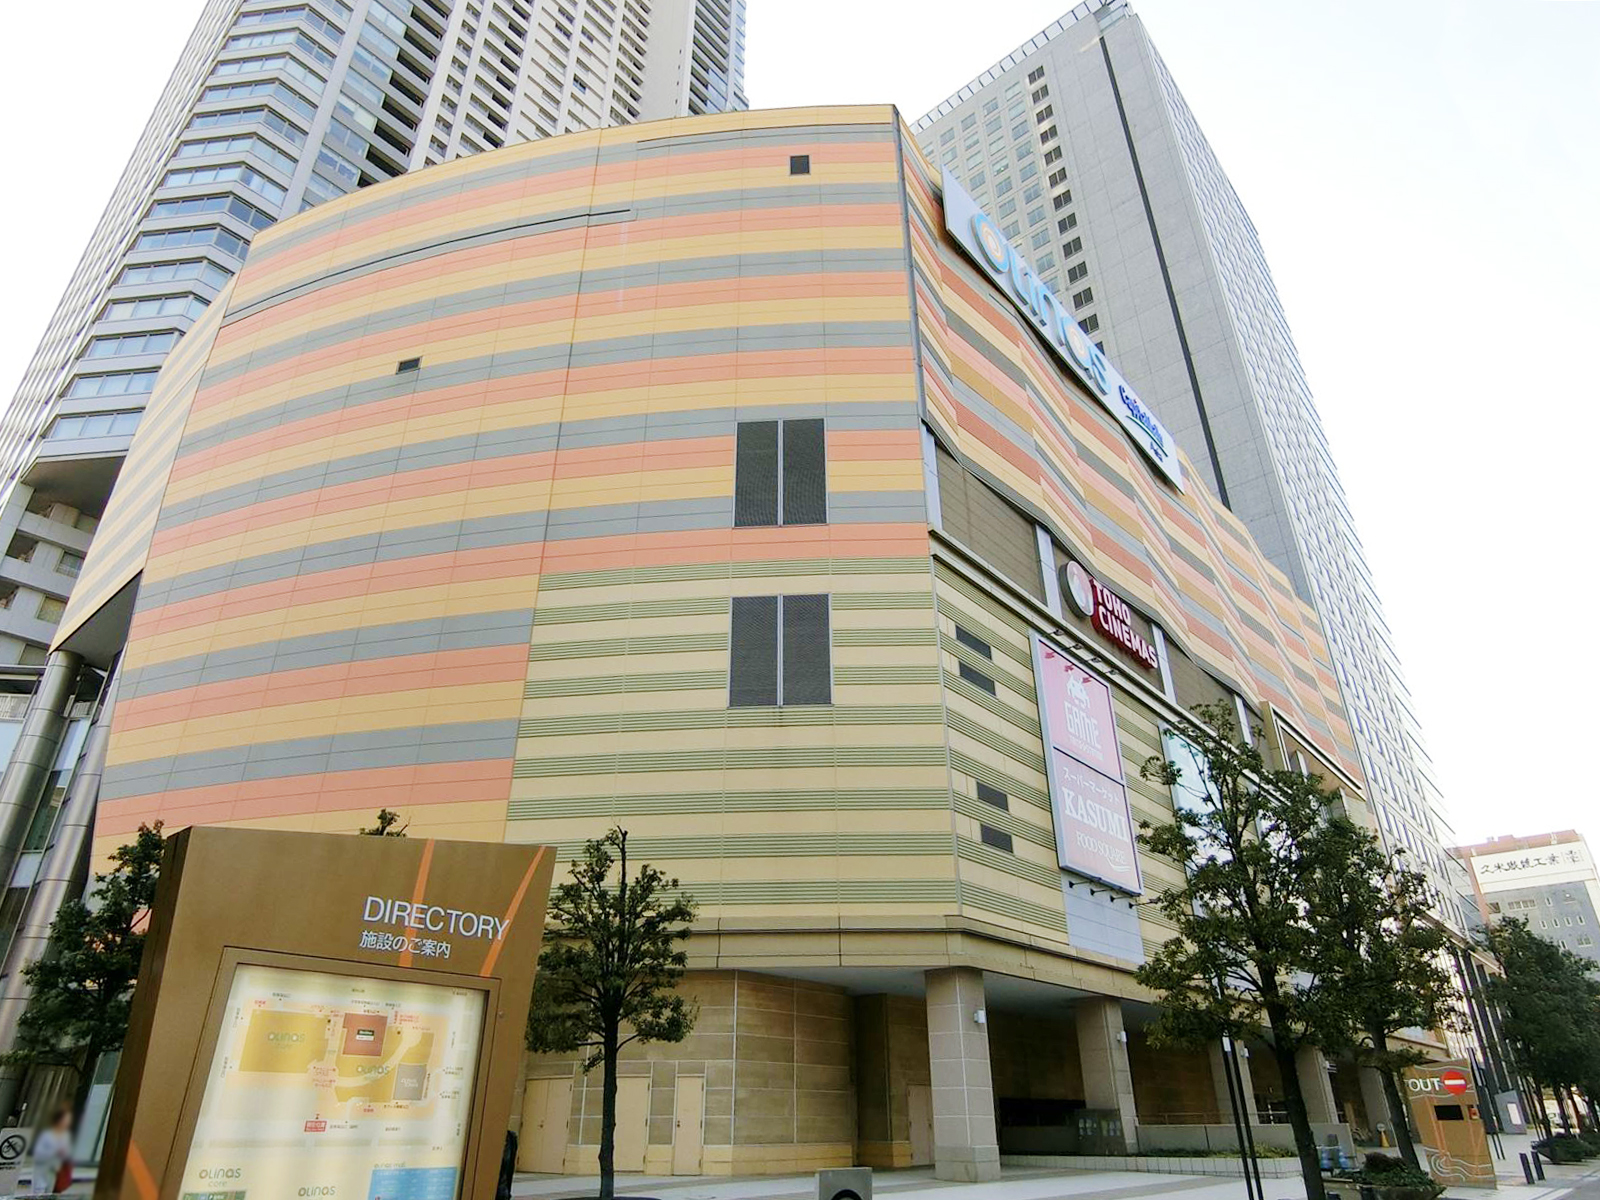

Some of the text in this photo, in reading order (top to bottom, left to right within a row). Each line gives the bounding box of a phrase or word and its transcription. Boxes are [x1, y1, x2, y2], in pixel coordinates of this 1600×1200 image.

[1092, 577, 1131, 626] TOHO
[1098, 605, 1158, 669] CINEMAS
[1061, 786, 1129, 843] KASUMI
[1076, 830, 1098, 852] FOOD
[363, 896, 510, 941] DIRECTORY
[359, 930, 451, 959] 施設のご案内
[1408, 1077, 1440, 1092] OUT
